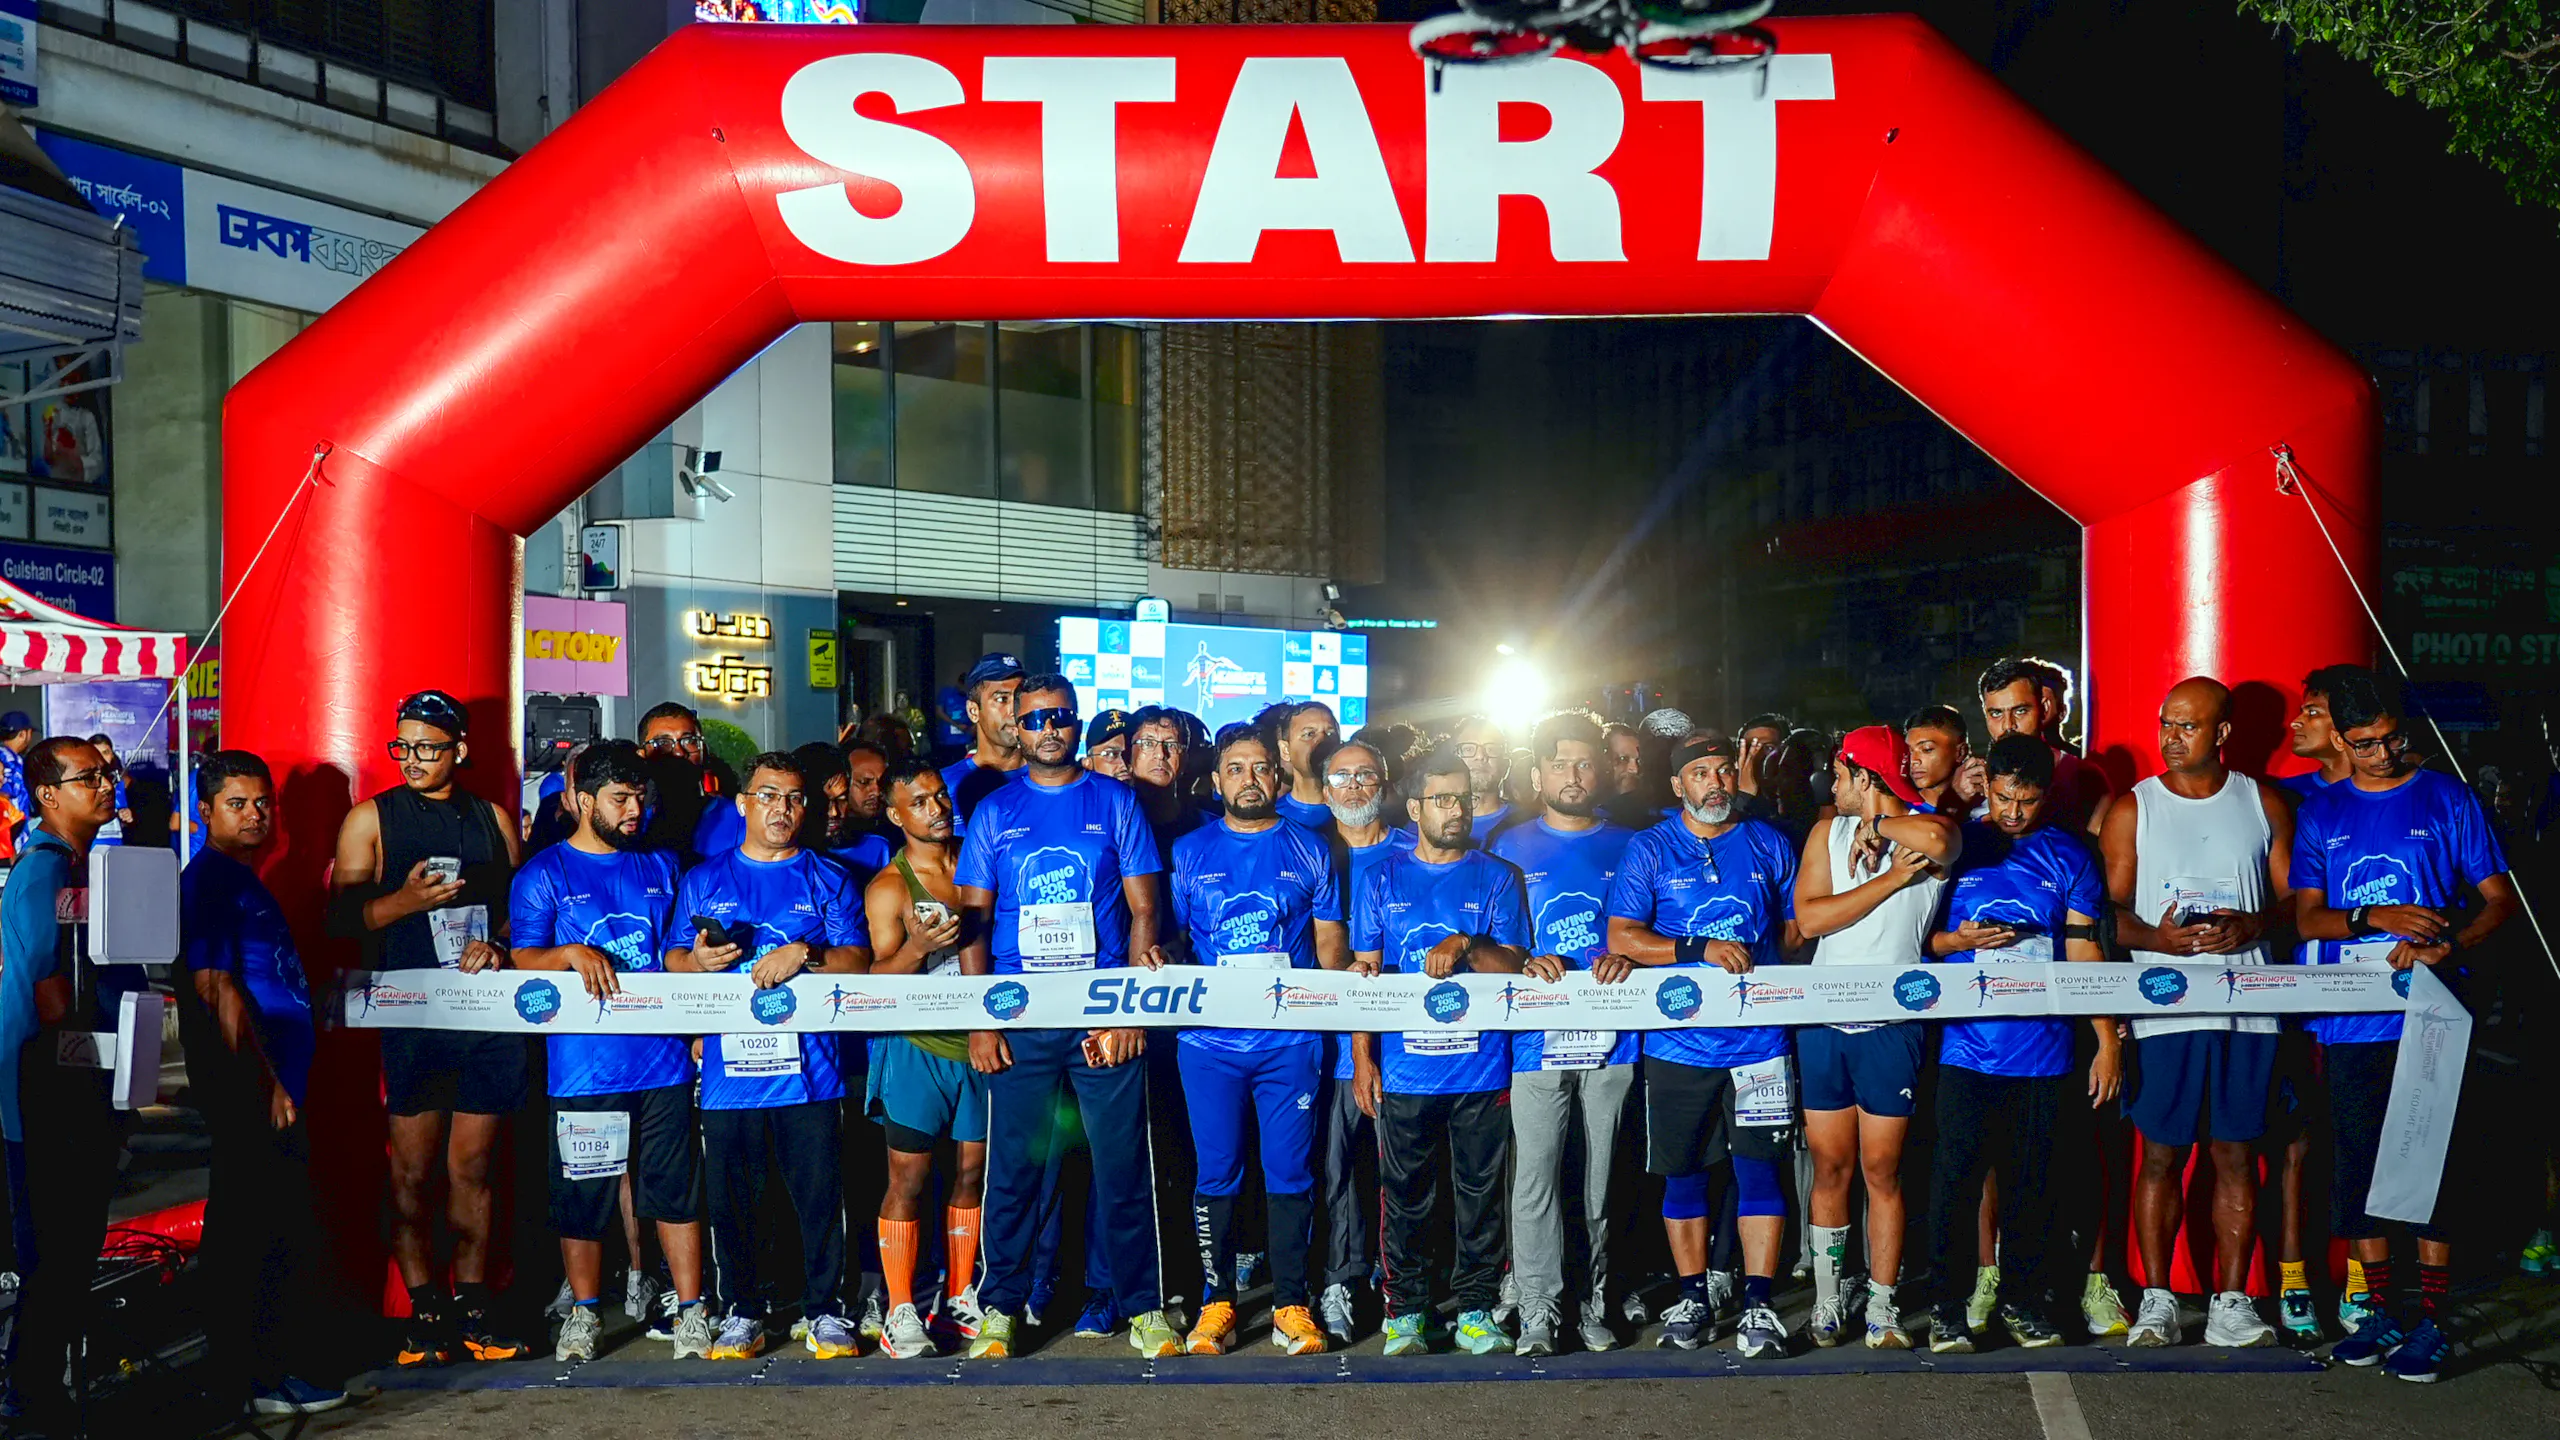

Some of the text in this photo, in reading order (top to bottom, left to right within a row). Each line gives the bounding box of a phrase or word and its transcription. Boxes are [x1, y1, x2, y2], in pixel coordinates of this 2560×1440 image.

[775, 52, 1835, 265] START
[217, 204, 312, 263] ঢাকা
[3, 558, 105, 587] Gulshan Circle-02
[1086, 823, 1102, 831] IHG
[1028, 865, 1075, 890] GIVING
[1039, 880, 1067, 898] FOR
[2347, 874, 2398, 901] GIVING
[795, 903, 812, 912] IHG
[1464, 902, 1480, 910] IHG
[1221, 909, 1269, 931] GIVING
[1546, 910, 1595, 935] GIVING
[1232, 923, 1260, 938] FOR
[1558, 923, 1589, 942] FOR
[1037, 932, 1075, 944] 10191
[1228, 931, 1270, 950] GOOD
[1555, 932, 1600, 955] GOOD
[1900, 978, 1930, 992] GIVING
[2054, 975, 2128, 984] CROWNE PLAZA
[2145, 973, 2176, 985] GIVING
[2154, 980, 2172, 989] FOR
[2240, 975, 2297, 983] MEANINGFUL
[1663, 985, 1692, 999] GIVING
[1752, 987, 1804, 996] MEANINGFUL
[1812, 981, 1882, 991] CROWNE PLAZA
[1908, 987, 1926, 997] FOR
[2151, 985, 2179, 997] GOOD
[376, 991, 428, 1000] MEANINGFUL
[435, 988, 505, 998] CROWNE PLAZA
[521, 989, 551, 1001] GIVING
[671, 993, 742, 1001] CROWNE PLAZA
[757, 991, 788, 1005] GIVING
[905, 992, 975, 1001] CROWNE PLAZA
[990, 988, 1020, 1000] GIVING
[1083, 977, 1208, 1015] Start
[1287, 993, 1339, 1001] MEANINGFUL
[1346, 989, 1415, 998] CROWNE PLAZA
[1430, 990, 1460, 1002] GIVING
[1518, 993, 1570, 1001] MEANINGFUL
[1577, 988, 1646, 997] CROWNE PLAZA
[1905, 990, 1932, 1003] GOOD
[528, 996, 546, 1006] FOR
[611, 996, 663, 1004] MEANINGFUL
[764, 999, 782, 1010] FOR
[997, 996, 1015, 1005] FOR
[1438, 998, 1455, 1007] FOR
[1670, 994, 1688, 1004] FOR
[526, 1002, 552, 1015] GOOD
[762, 1004, 788, 1017] GOOD
[994, 999, 1021, 1012] GOOD
[1435, 1003, 1461, 1014] GOOD
[1668, 999, 1695, 1012] GOOD
[1560, 1030, 1598, 1043] 10178
[740, 1037, 779, 1049] 10202
[571, 1140, 610, 1153] 10184
[1196, 1206, 1212, 1247] XAVIA
